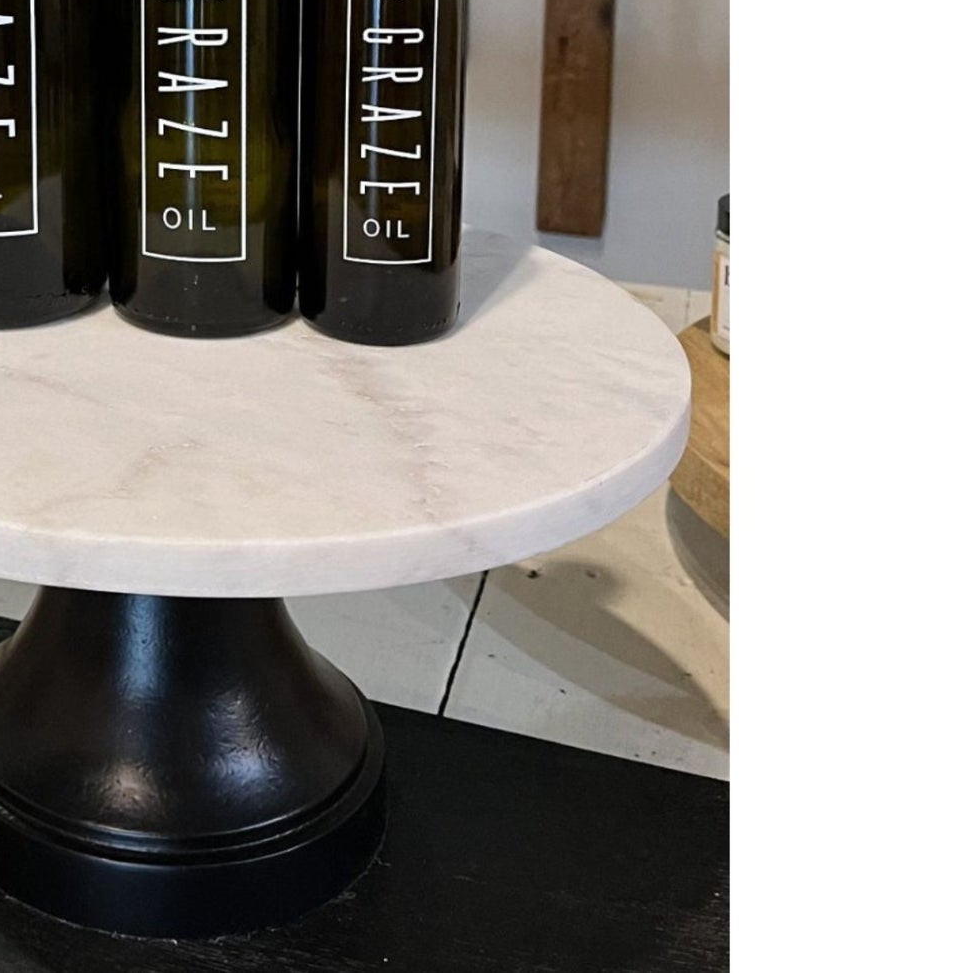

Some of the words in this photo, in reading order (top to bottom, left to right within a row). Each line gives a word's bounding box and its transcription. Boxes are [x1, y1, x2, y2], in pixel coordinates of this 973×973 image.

[359, 27, 425, 196] GRAZE
[162, 207, 216, 231] OIL
[362, 218, 410, 239] OIL
